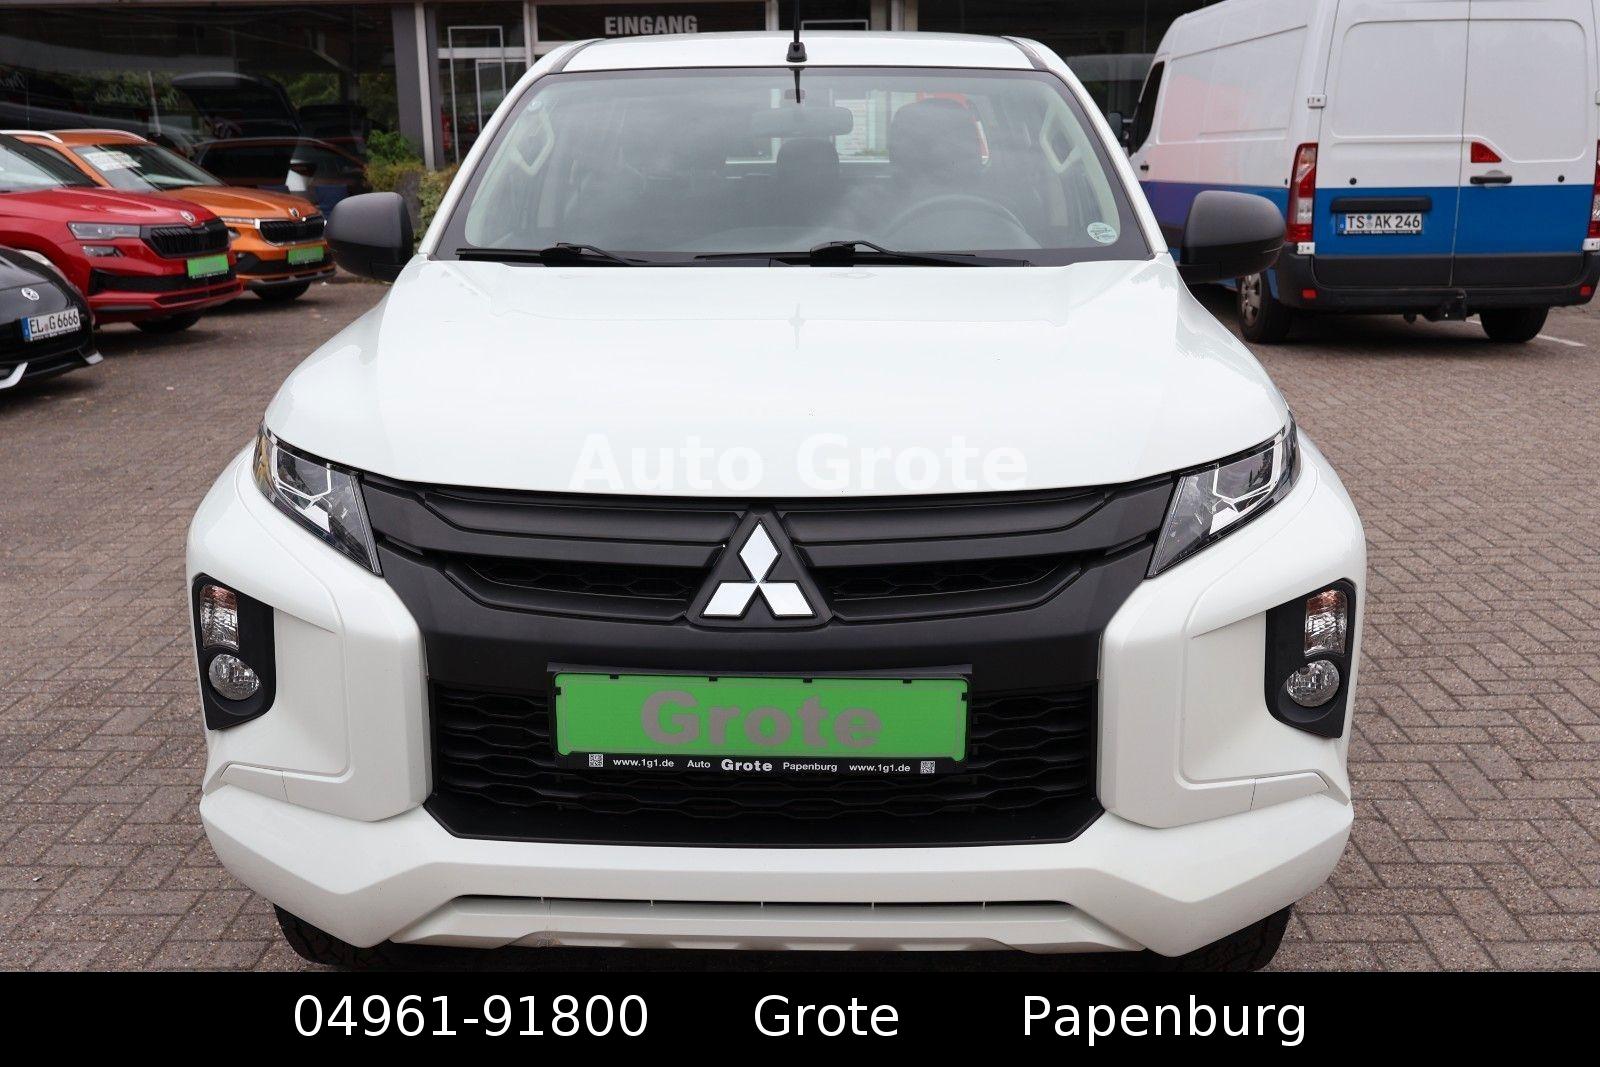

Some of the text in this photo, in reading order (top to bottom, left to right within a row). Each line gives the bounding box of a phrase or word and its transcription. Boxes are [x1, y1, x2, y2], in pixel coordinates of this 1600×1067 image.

[605, 15, 697, 35] EINGANG
[1394, 214, 1420, 229] 246
[641, 690, 882, 749] Grote
[613, 758, 911, 774] www.1g1.de Auto Grote Papenburg www.1g1.de
